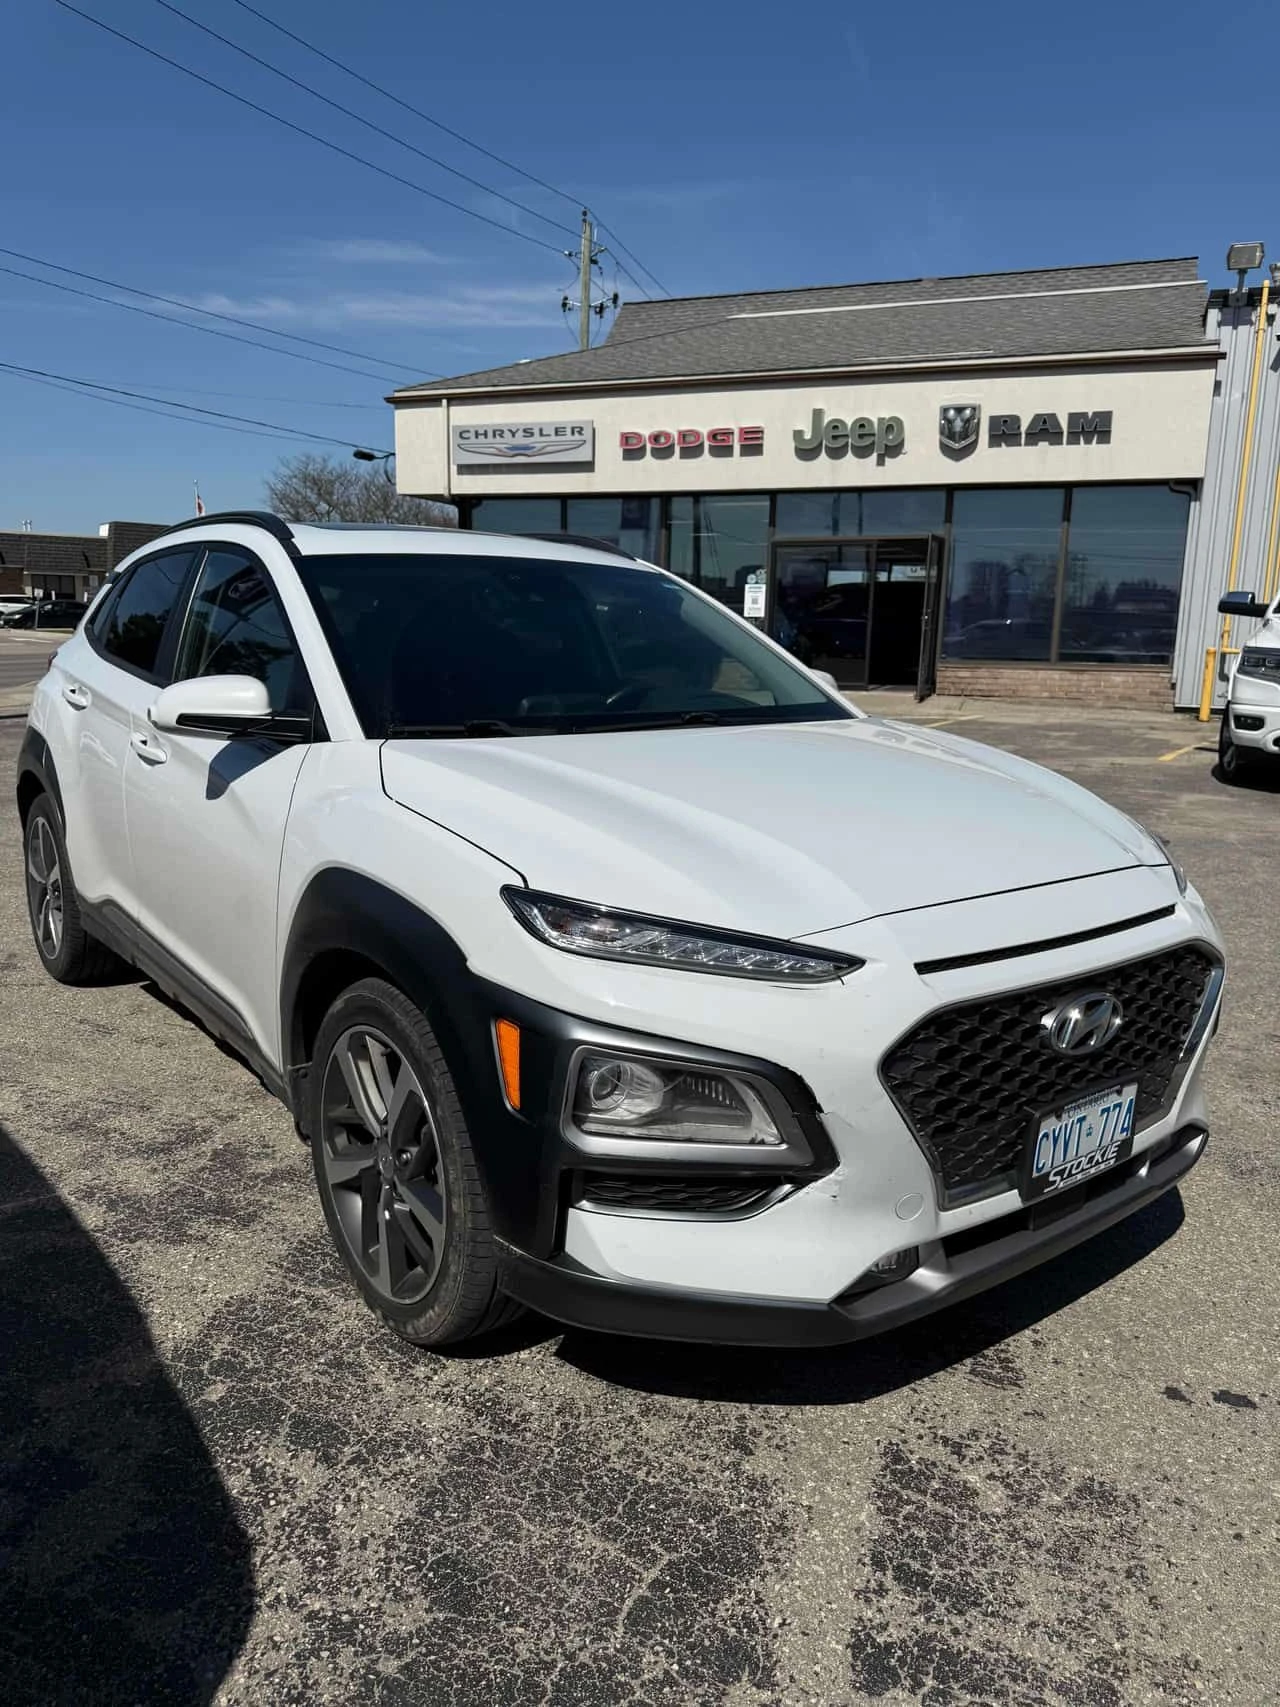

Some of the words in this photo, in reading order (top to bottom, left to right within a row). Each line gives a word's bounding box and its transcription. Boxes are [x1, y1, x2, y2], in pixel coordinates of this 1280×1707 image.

[459, 426, 585, 440] CHRYSLER
[620, 426, 764, 449] DODGE
[792, 408, 905, 461] Jeep
[988, 411, 1113, 440] RAM
[1034, 1115, 1087, 1175] CYVT
[1097, 1097, 1135, 1147] 774
[1043, 1141, 1121, 1192] STOCKIE
